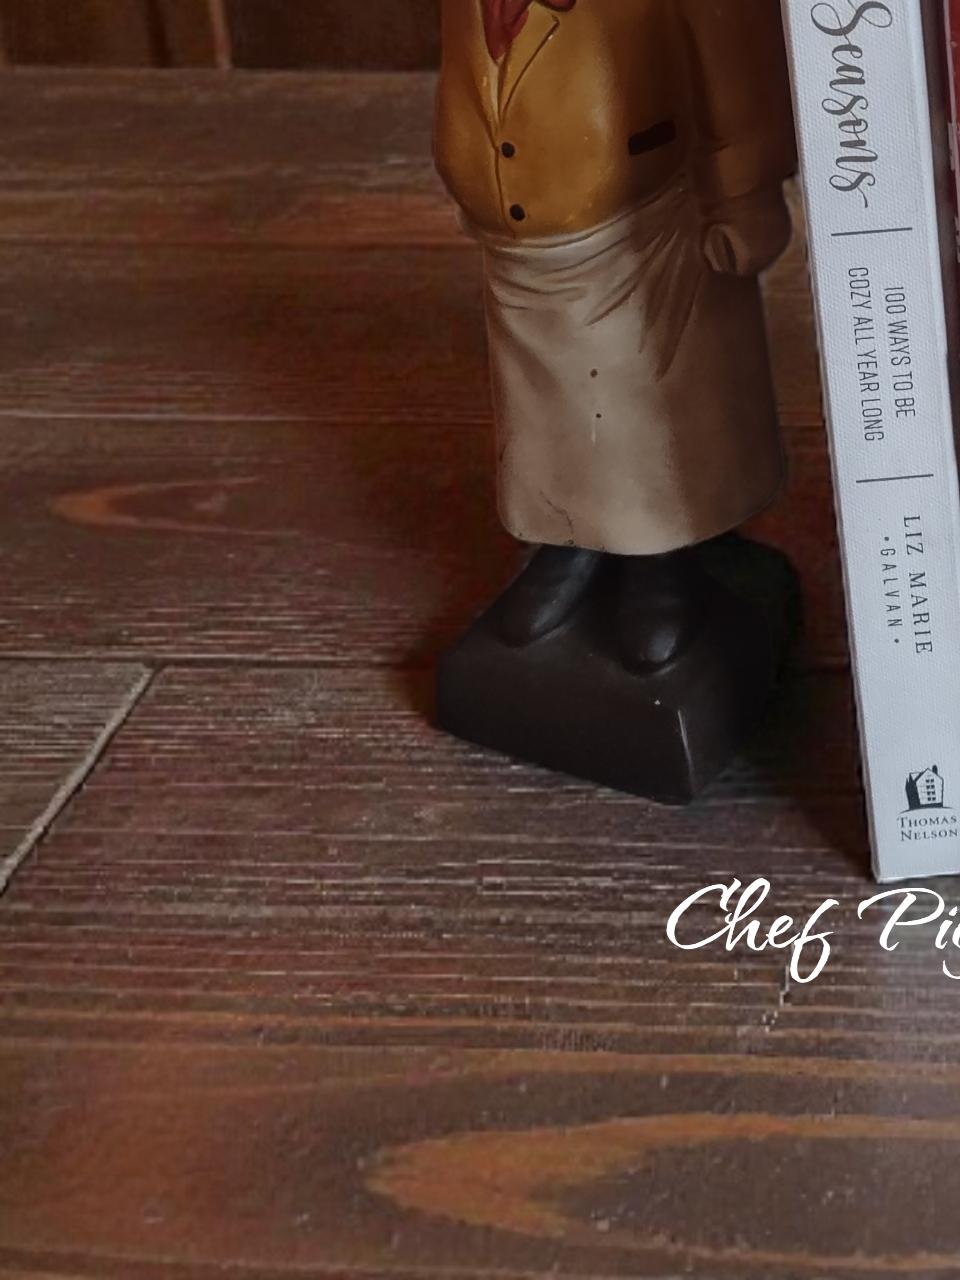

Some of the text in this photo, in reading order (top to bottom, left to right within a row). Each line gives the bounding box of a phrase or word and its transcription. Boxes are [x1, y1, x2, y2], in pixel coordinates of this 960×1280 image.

[848, 267, 884, 441] COZY ALL YEAR LONG
[884, 286, 916, 418] 100 WAYS TO BE
[903, 515, 933, 654] LIZ MARIE
[897, 815, 958, 828] THOMAS
[900, 828, 958, 841] NELSON
